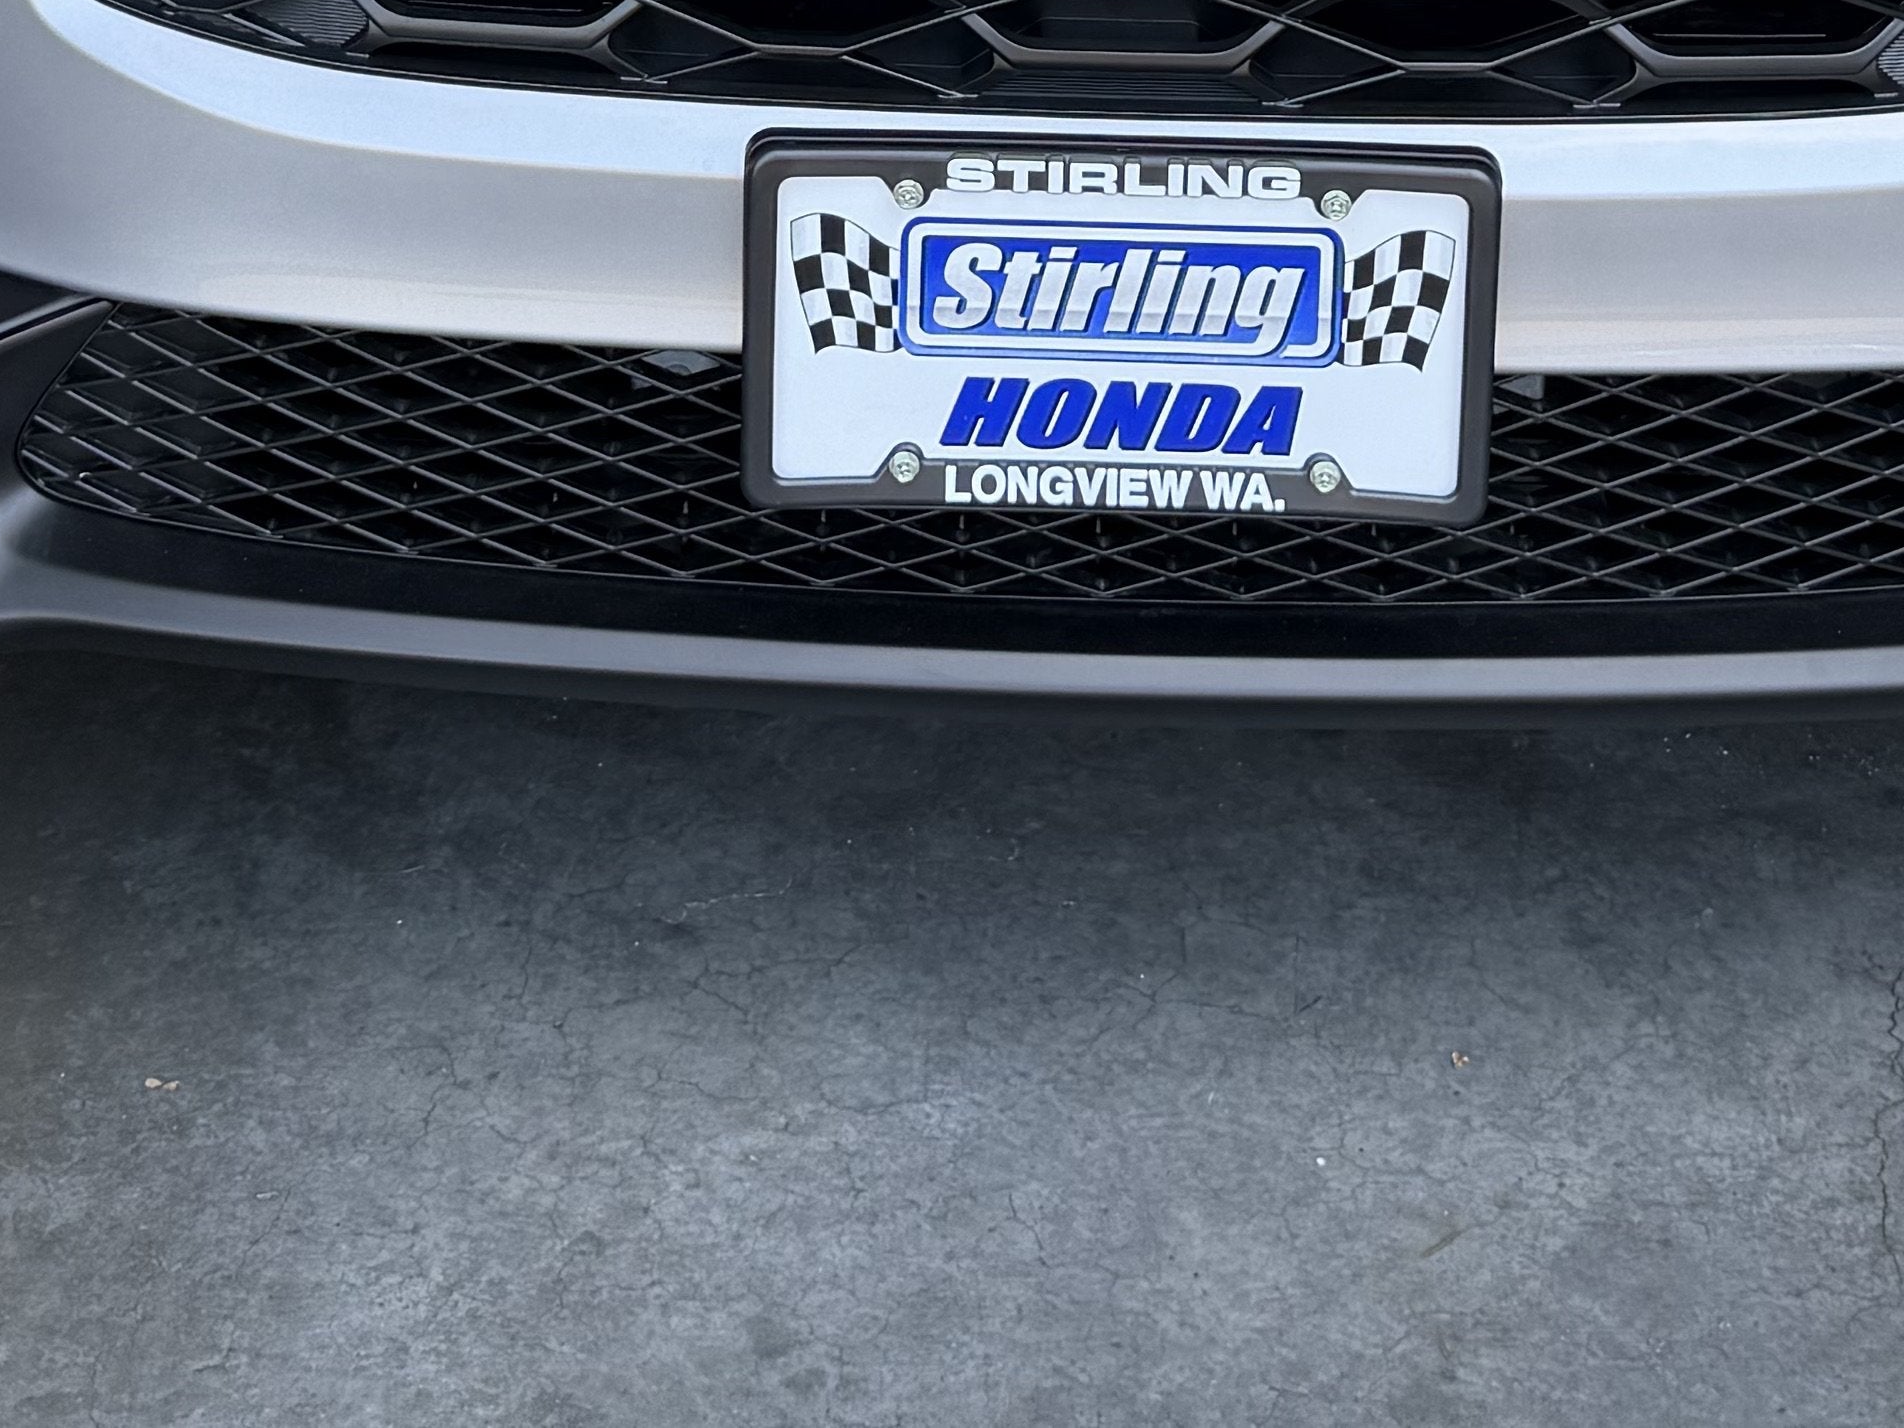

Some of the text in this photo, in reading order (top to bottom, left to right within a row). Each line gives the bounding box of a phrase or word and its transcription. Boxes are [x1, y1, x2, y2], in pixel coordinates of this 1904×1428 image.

[946, 156, 1302, 200] STIRLING
[932, 242, 1305, 356] Stirling
[939, 376, 1303, 456] HONDA
[944, 464, 1286, 512] LONGVIEW WA.
